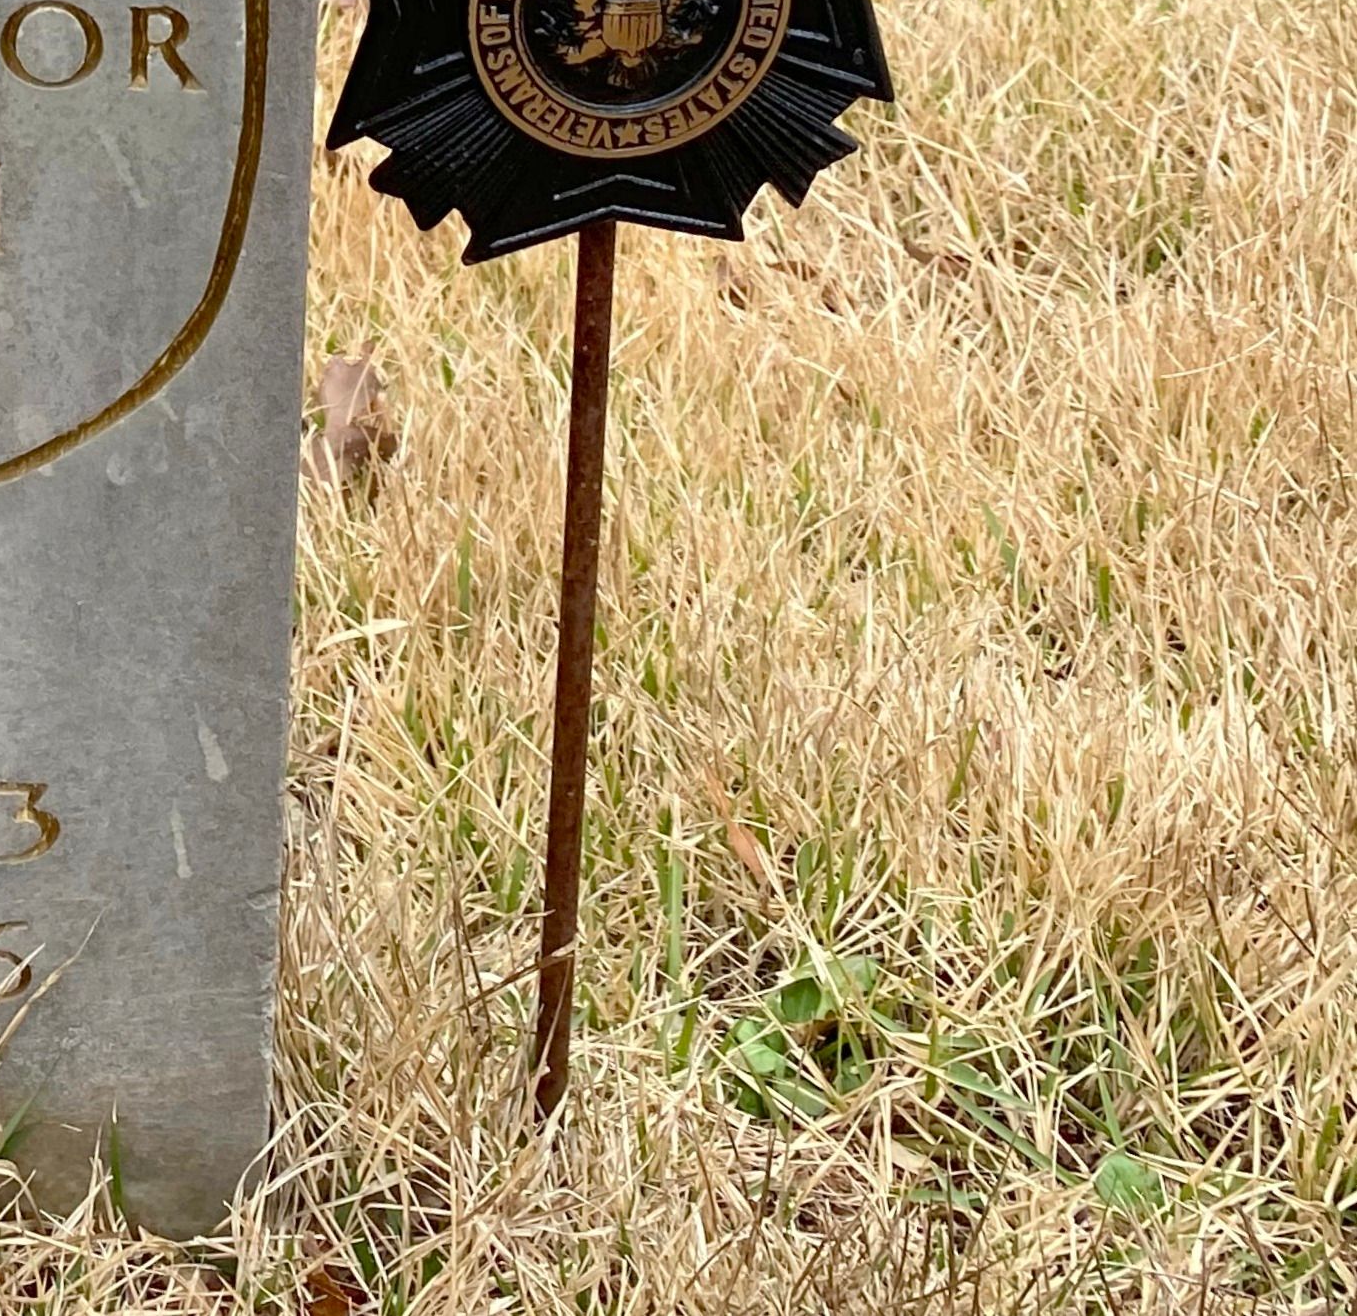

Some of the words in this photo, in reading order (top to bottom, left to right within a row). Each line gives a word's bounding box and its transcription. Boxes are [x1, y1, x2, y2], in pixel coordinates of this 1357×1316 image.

[480, 5, 510, 46] OF
[487, 51, 613, 149] VETERANS
[644, 52, 757, 140] STATES
